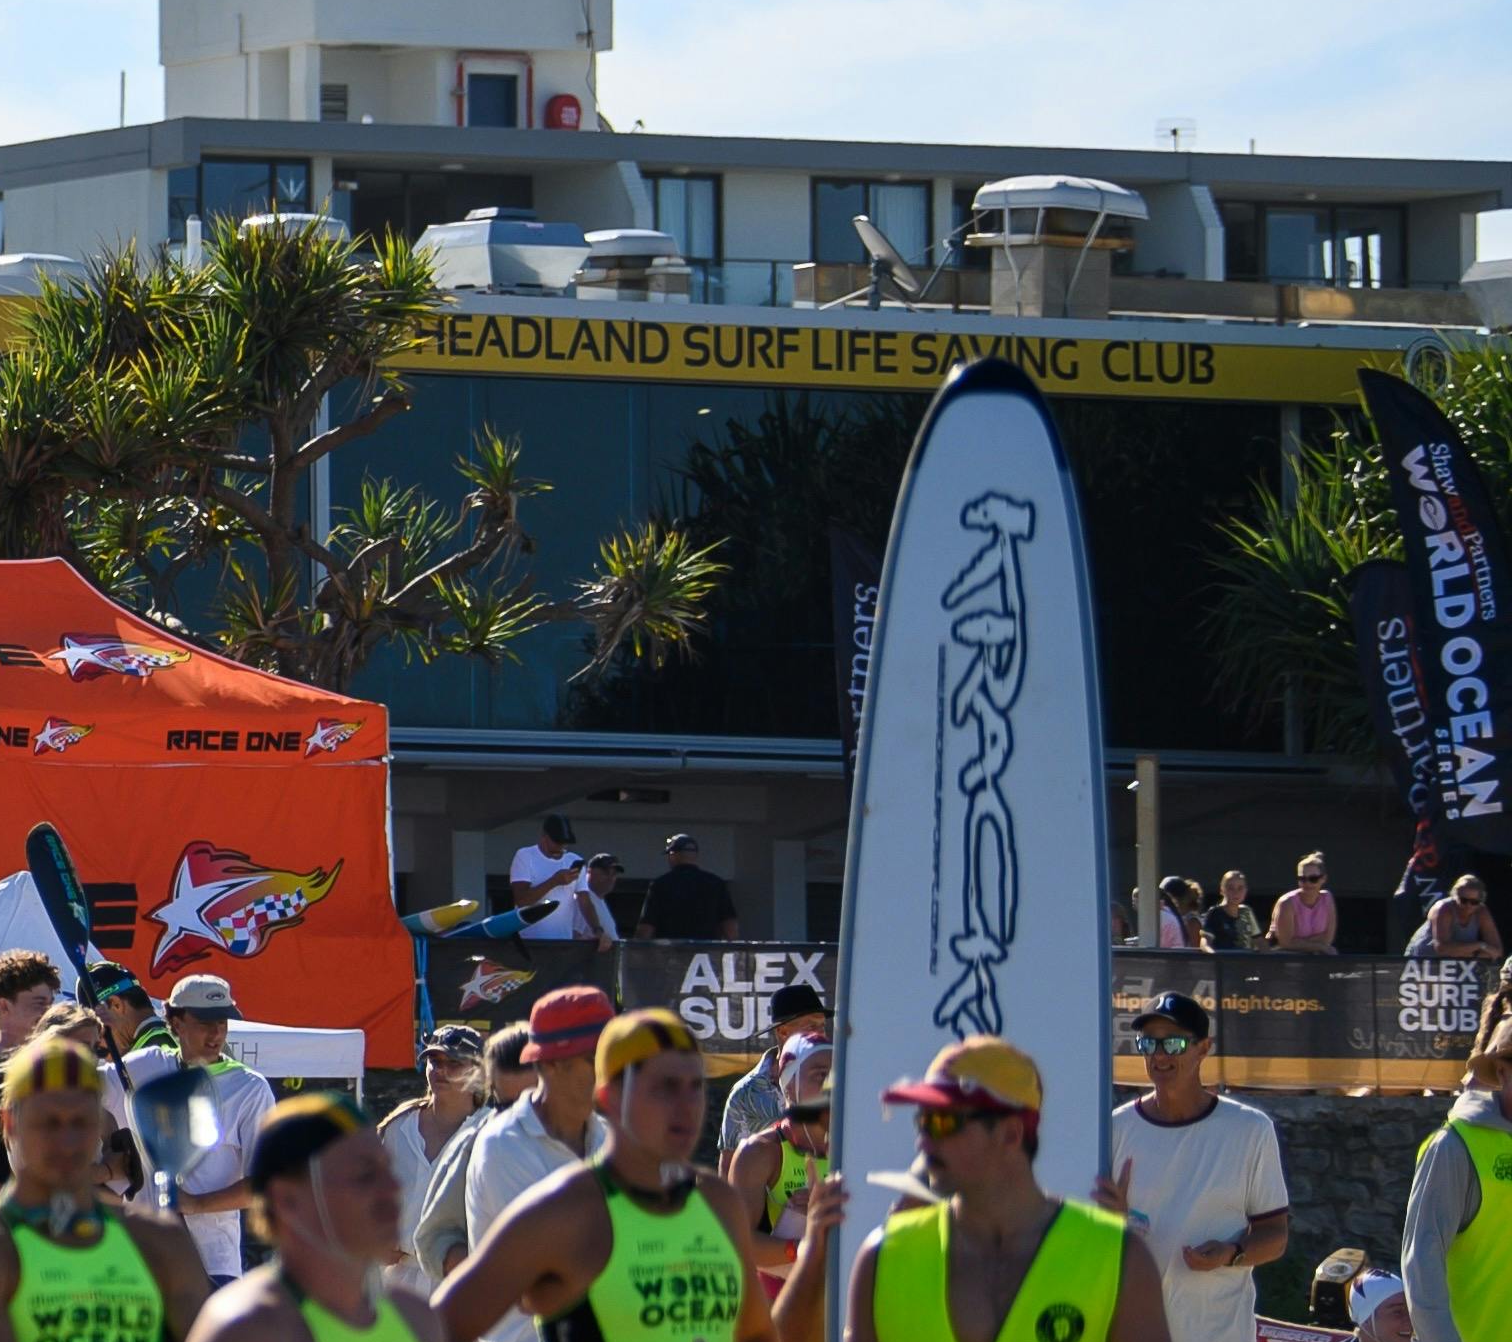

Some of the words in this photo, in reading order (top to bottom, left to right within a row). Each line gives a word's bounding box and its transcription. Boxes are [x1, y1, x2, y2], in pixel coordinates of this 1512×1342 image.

[413, 313, 670, 365] HEADLAND
[683, 324, 800, 370] SURF
[810, 330, 900, 375] LIFE
[1100, 341, 1216, 386] CLUB
[1400, 443, 1477, 629] WORLD
[1439, 635, 1505, 821] OCEAN
[166, 730, 240, 752] RACE
[245, 731, 302, 752] ONE
[1434, 727, 1460, 821] SERIES
[679, 952, 825, 994] ALEX
[1398, 960, 1479, 983] ALEX
[1221, 991, 1326, 1016] nightcaps.
[1398, 984, 1479, 1007] SURF
[1398, 1007, 1479, 1032] CLUB
[634, 1273, 739, 1300] WORLD
[27, 1301, 156, 1332] WORLD
[638, 1299, 740, 1328] OCEAN
